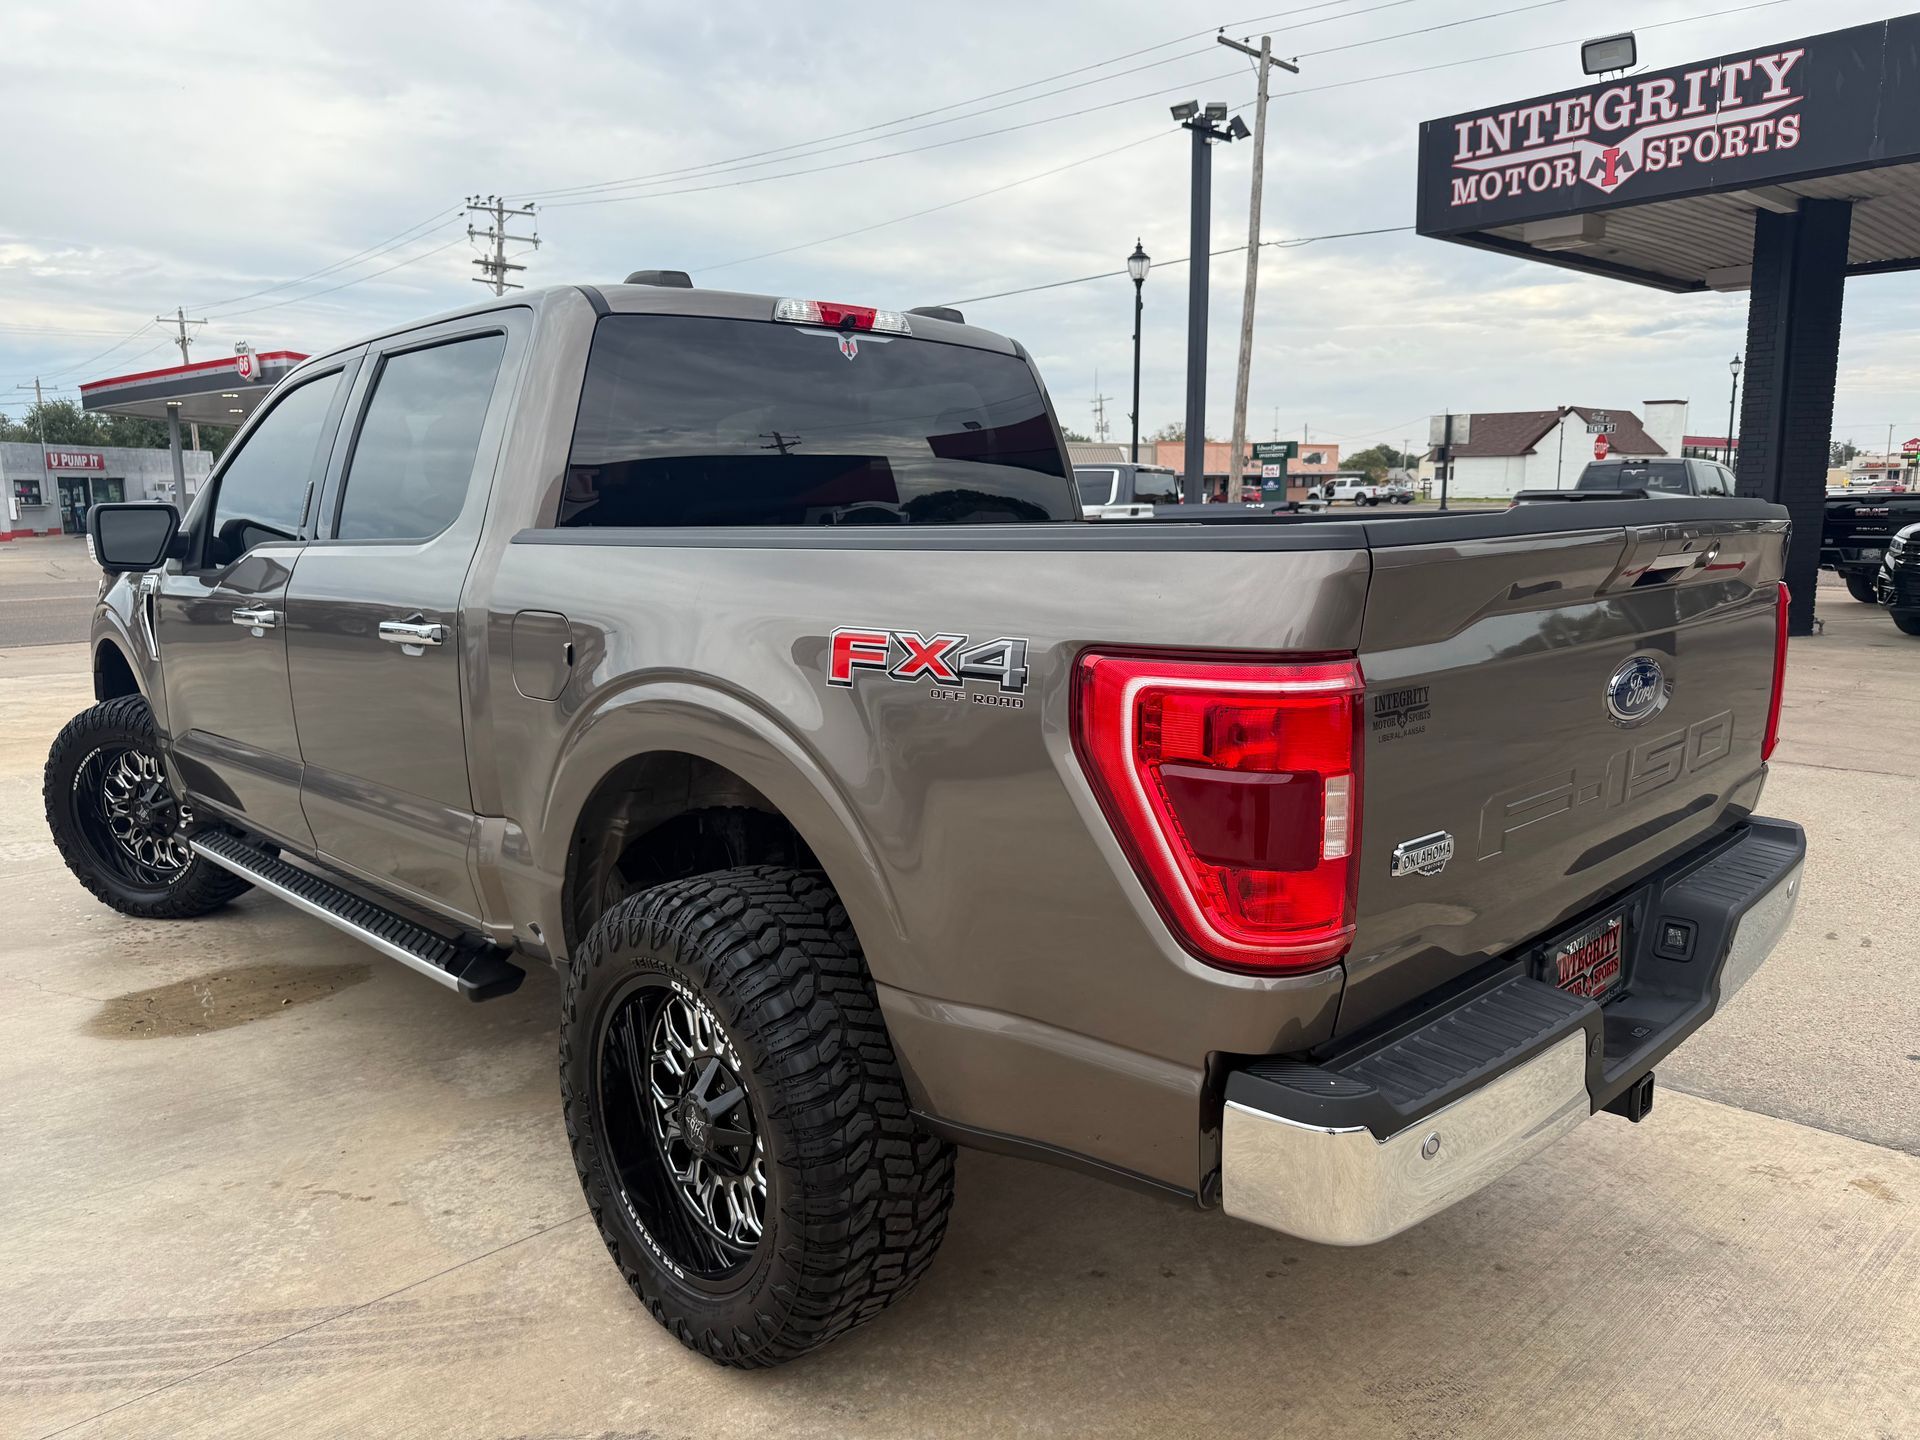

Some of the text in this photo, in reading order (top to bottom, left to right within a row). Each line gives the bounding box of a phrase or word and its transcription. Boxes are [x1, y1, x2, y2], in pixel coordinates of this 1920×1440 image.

[1453, 48, 1805, 162] INTEGRITY
[1451, 113, 1801, 207] MOTOR SPORTS
[239, 356, 249, 372] 66
[50, 453, 99, 467] U PUMP IT
[1595, 442, 1608, 454] STOP
[1855, 507, 1889, 517] GMC
[826, 625, 1030, 695] FX4
[930, 689, 1024, 709] OFF ROAD
[1374, 686, 1430, 713] INTEGRITY
[1626, 672, 1658, 708] Ford
[1373, 709, 1431, 731] MOTOR SPORTS
[1404, 725, 1425, 737] KANSAS
[1478, 709, 1735, 861] F-150
[1404, 841, 1451, 870] OKLAHOMA
[1556, 923, 1620, 987] INTEGRITY
[1594, 957, 1619, 985] SPORTS
[663, 1256, 685, 1280] HD
